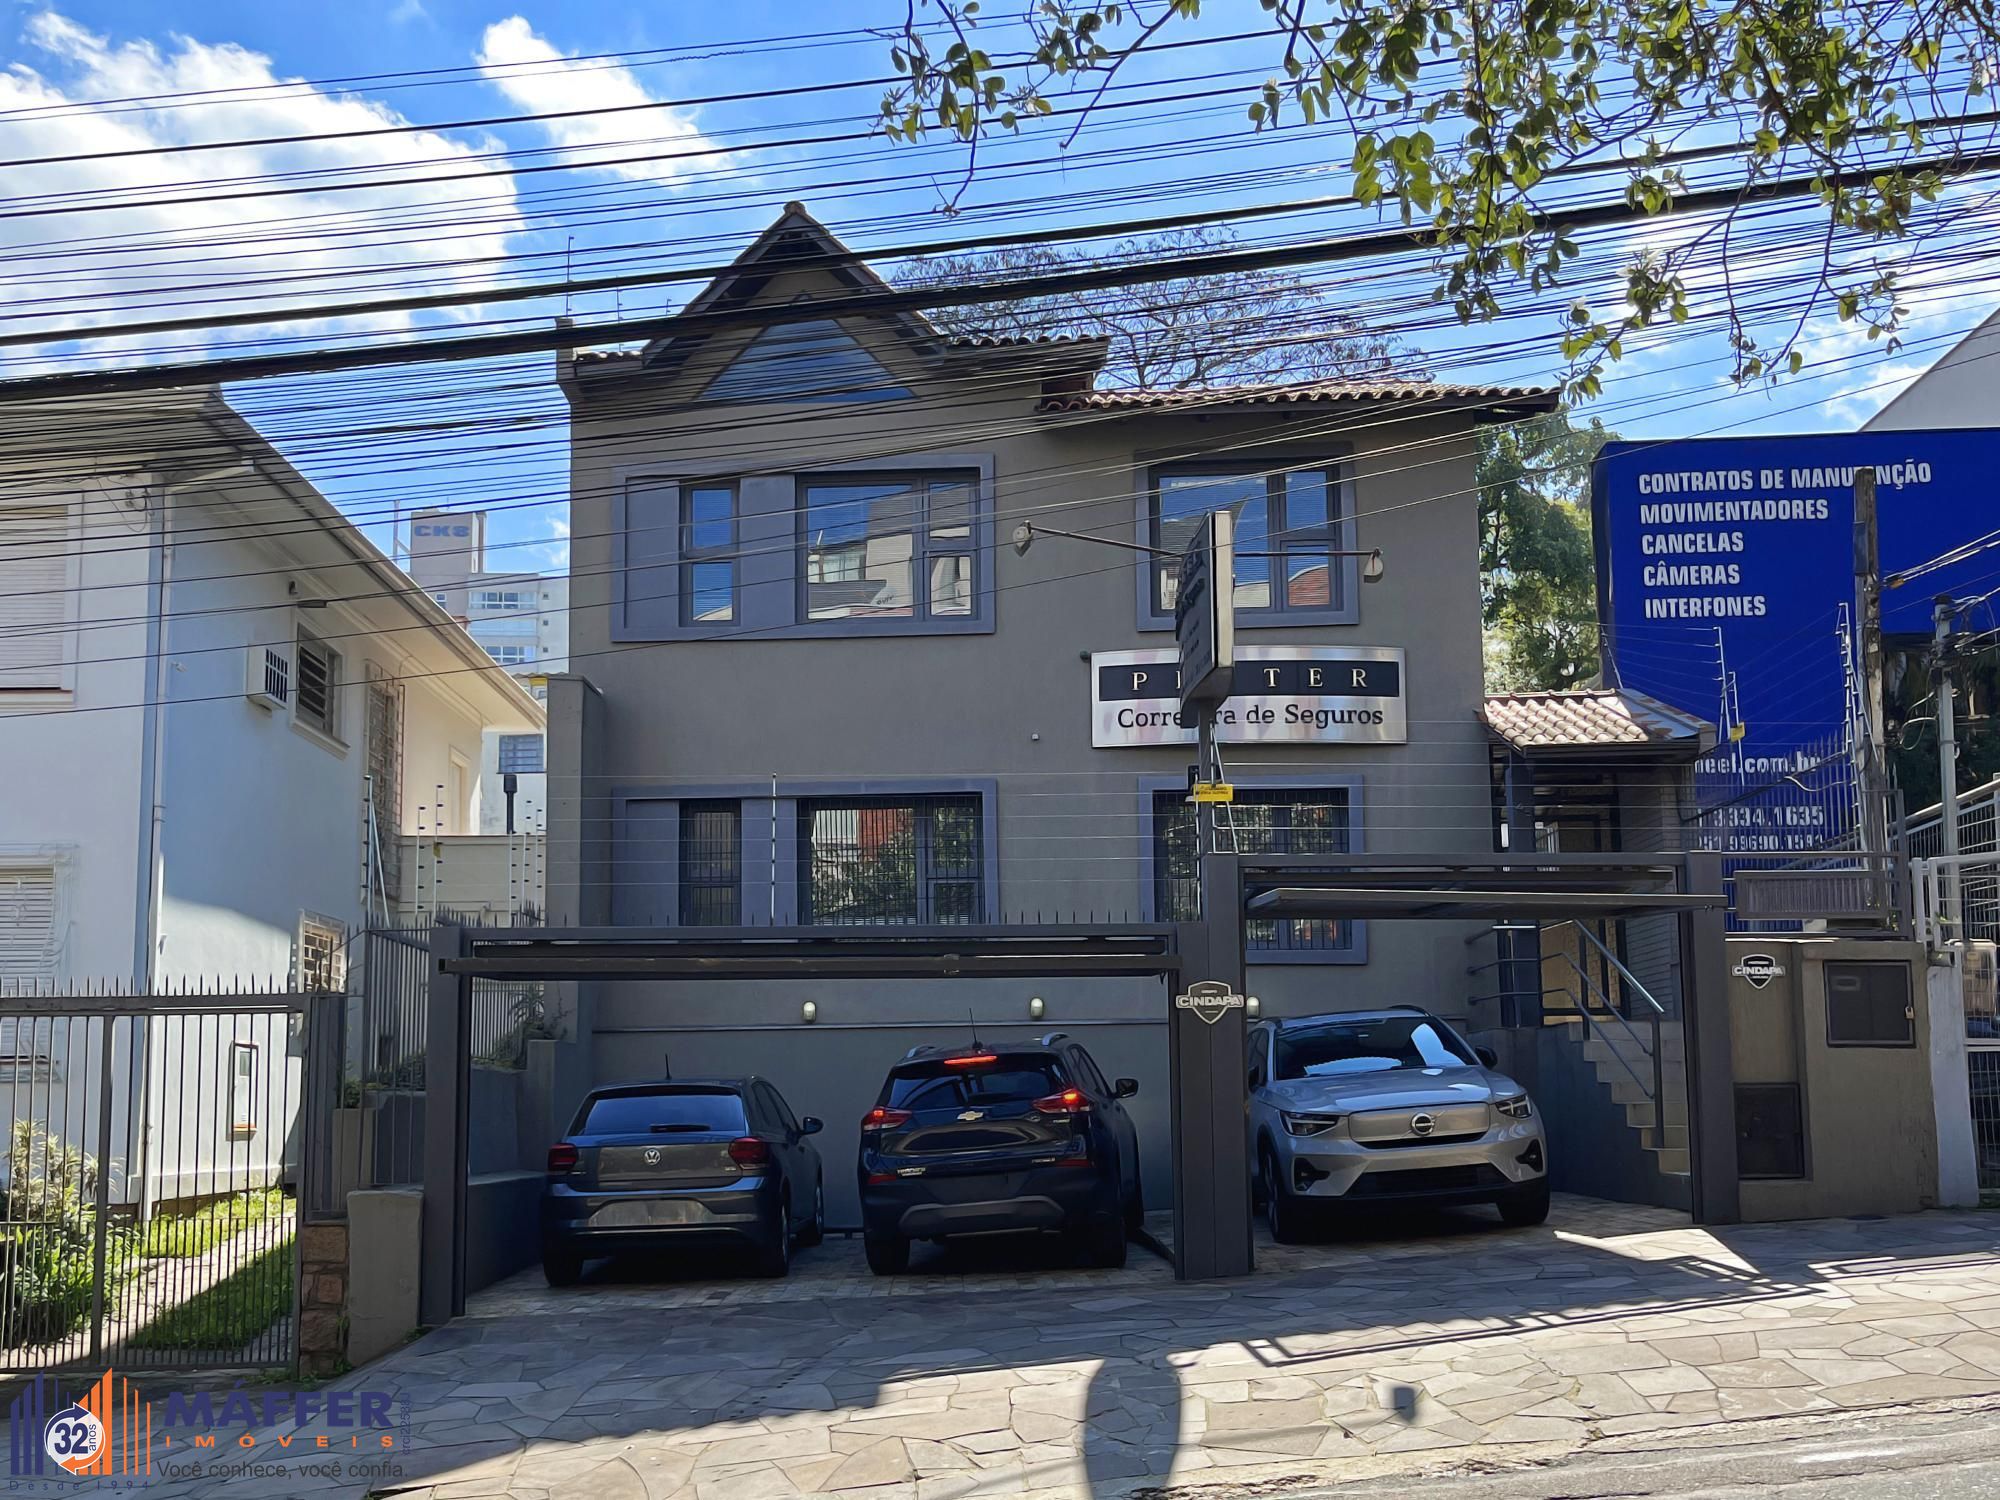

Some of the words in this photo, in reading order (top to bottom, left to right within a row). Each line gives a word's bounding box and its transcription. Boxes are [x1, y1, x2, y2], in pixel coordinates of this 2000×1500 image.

[1639, 470, 1754, 494] CONTRATOS
[1760, 468, 1784, 490] DE
[1791, 458, 1932, 490] MANUNÇÃO
[1640, 499, 1829, 524] MOVIMENTADORES
[1642, 532, 1744, 554] CANCELAS
[1643, 560, 1740, 586] CÂMERAS
[1645, 596, 1766, 618] INTERFONES
[1132, 667, 1367, 690] PTER
[1118, 707, 1237, 729] Correra
[1246, 705, 1275, 724] de
[1284, 704, 1384, 729] Seguros
[1733, 966, 1783, 975] CINDAPA
[1179, 996, 1241, 1006] CINDAPA
